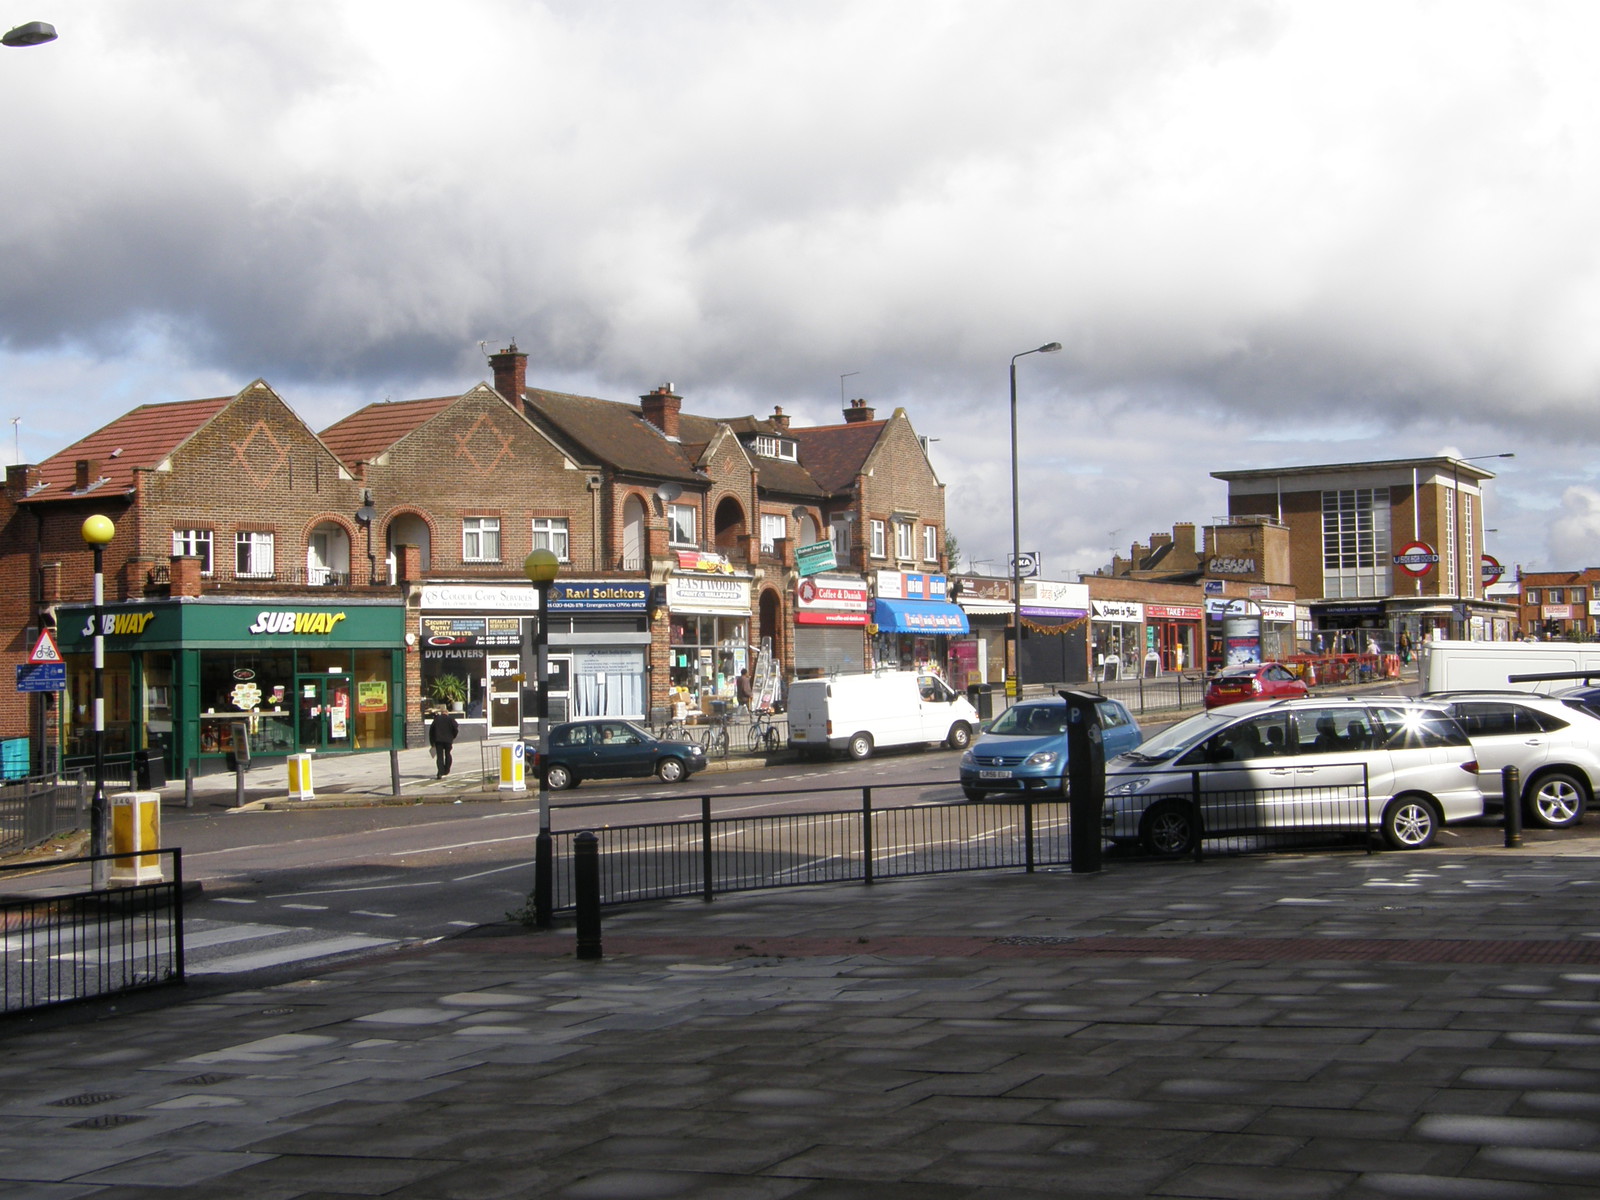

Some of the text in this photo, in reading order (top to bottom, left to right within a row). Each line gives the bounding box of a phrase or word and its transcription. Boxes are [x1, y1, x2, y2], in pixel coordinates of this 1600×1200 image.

[677, 577, 742, 591] EASTWOODS
[565, 588, 646, 599] Ravi Solicitors
[818, 589, 862, 600] Coffee & Danish
[1166, 607, 1180, 617] TAKE
[1180, 608, 1185, 617] 7
[248, 611, 347, 635] SUBWAY
[424, 619, 452, 627] SECURITY
[425, 649, 484, 659] DVD PLAYERS
[498, 660, 510, 669] 020
[1071, 707, 1080, 723] P
